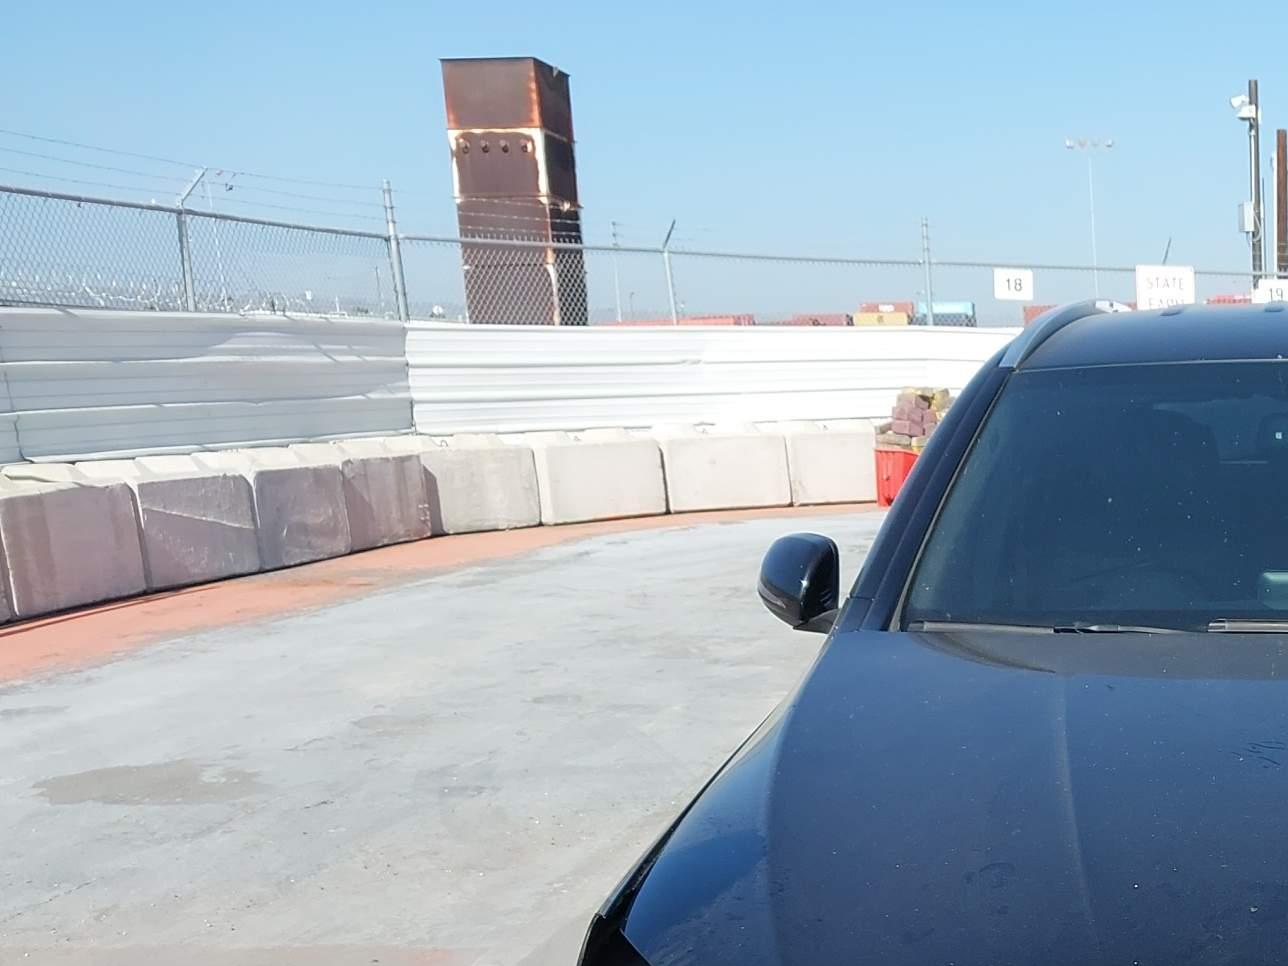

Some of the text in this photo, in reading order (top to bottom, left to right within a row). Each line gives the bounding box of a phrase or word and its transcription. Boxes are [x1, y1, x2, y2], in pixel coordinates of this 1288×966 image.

[1006, 278, 1023, 292] 18
[1146, 277, 1184, 290] STATE
[1269, 288, 1284, 302] 19
